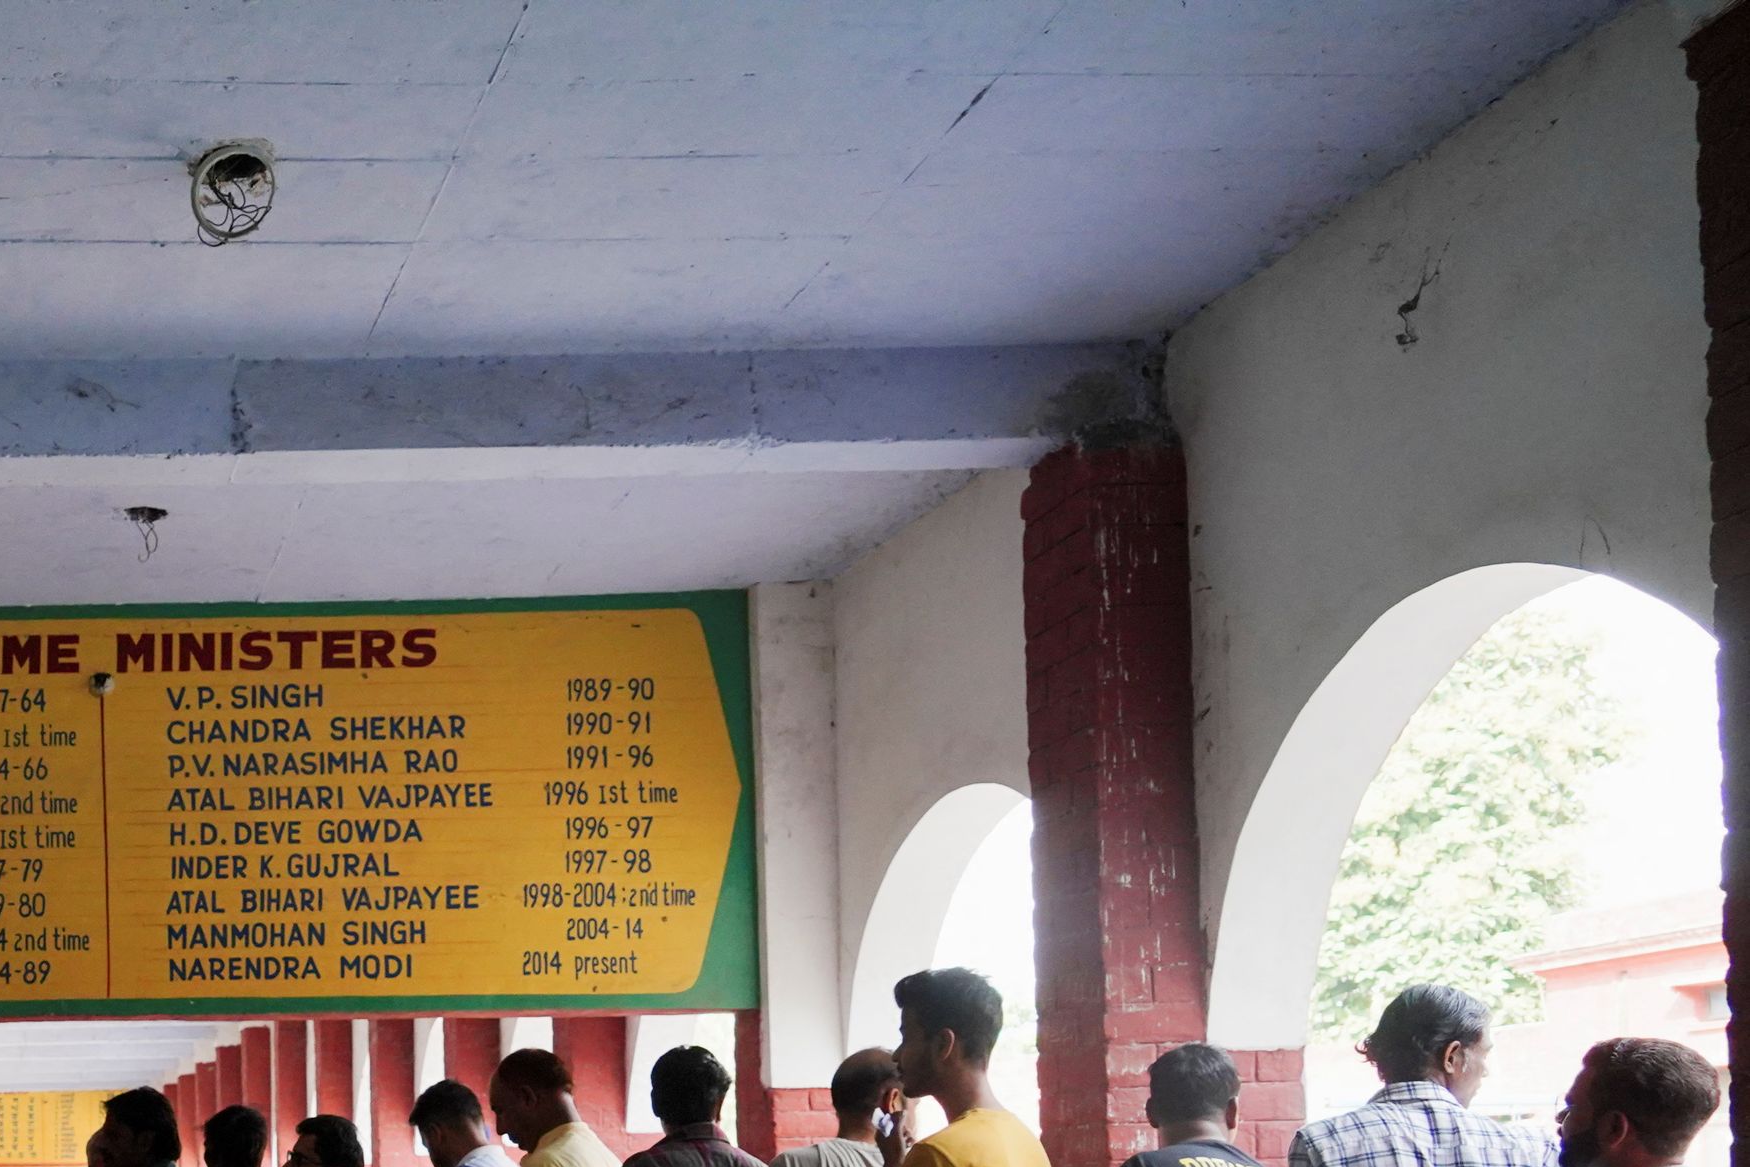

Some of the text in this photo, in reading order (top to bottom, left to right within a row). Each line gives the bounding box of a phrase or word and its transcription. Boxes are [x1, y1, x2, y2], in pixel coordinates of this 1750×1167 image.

[116, 628, 437, 674] MINISTERS
[230, 683, 324, 710] SINGH
[39, 723, 77, 747] time
[166, 717, 312, 745] CHANDRA
[329, 714, 466, 742] SHEKHAR
[222, 750, 389, 777] NARASIMHA
[403, 748, 458, 774] RAO
[0, 790, 34, 816] 2nd
[39, 791, 78, 815] time
[166, 787, 236, 812] ATAL
[248, 785, 344, 811] BIHARI
[357, 782, 493, 809] VAJPAYEE
[543, 780, 589, 806] 1996
[638, 781, 678, 804] time
[34, 825, 76, 849] time
[234, 820, 302, 846] DEVE
[317, 818, 423, 844] GOWDA
[171, 854, 248, 880] INDER
[287, 852, 400, 879] GUJRAL
[166, 890, 226, 916] ATAL
[240, 887, 323, 914] BIHARI
[341, 884, 480, 912] VAJPAYEE
[662, 882, 696, 907] time
[13, 927, 47, 952] 2nd
[52, 927, 90, 952] time
[166, 922, 326, 950] MANMOHAN
[342, 920, 427, 946] SINGH
[168, 950, 638, 982] NARENDRA MODI 2014 present
